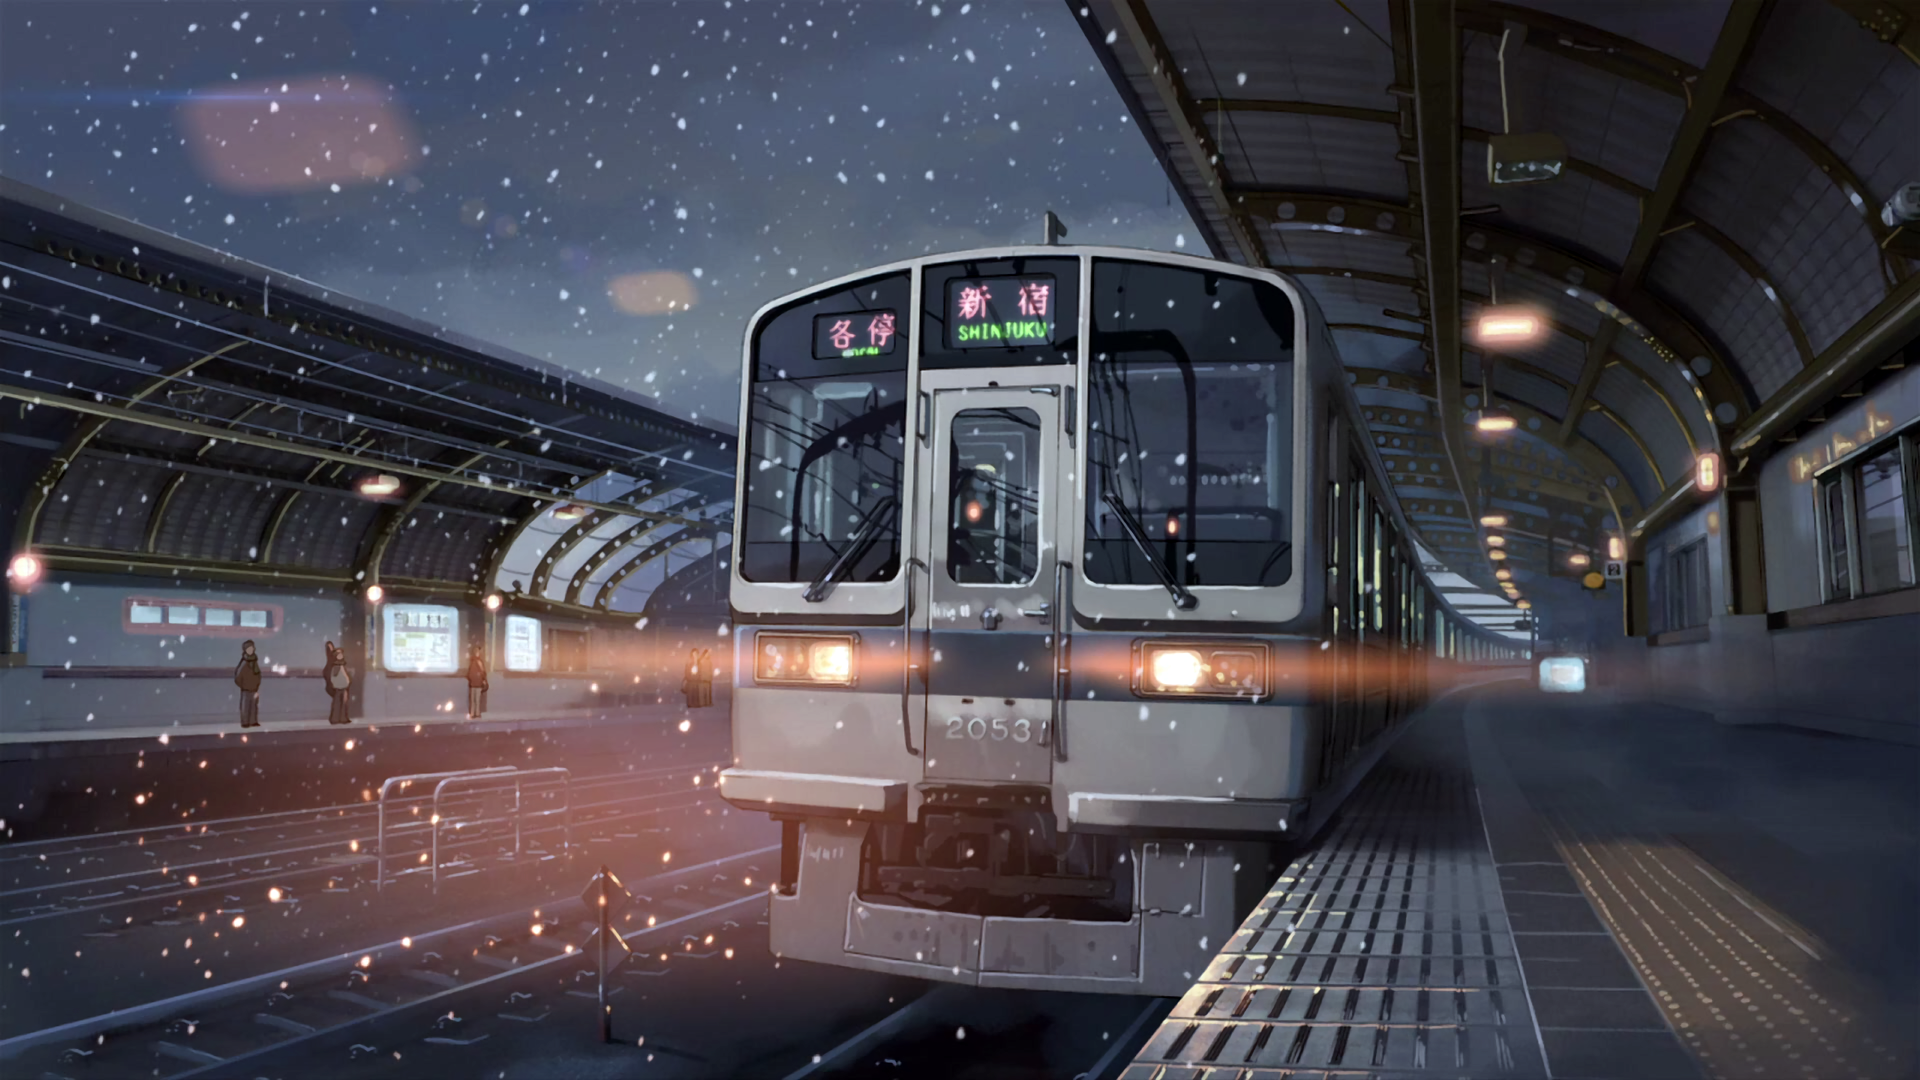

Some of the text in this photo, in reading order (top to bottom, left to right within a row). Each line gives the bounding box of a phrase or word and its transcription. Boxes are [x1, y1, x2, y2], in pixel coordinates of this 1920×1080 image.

[957, 283, 1050, 320] 新宿
[829, 313, 895, 348] 各停
[957, 321, 1048, 342] SHINJUKU
[945, 716, 1031, 742] 2053
